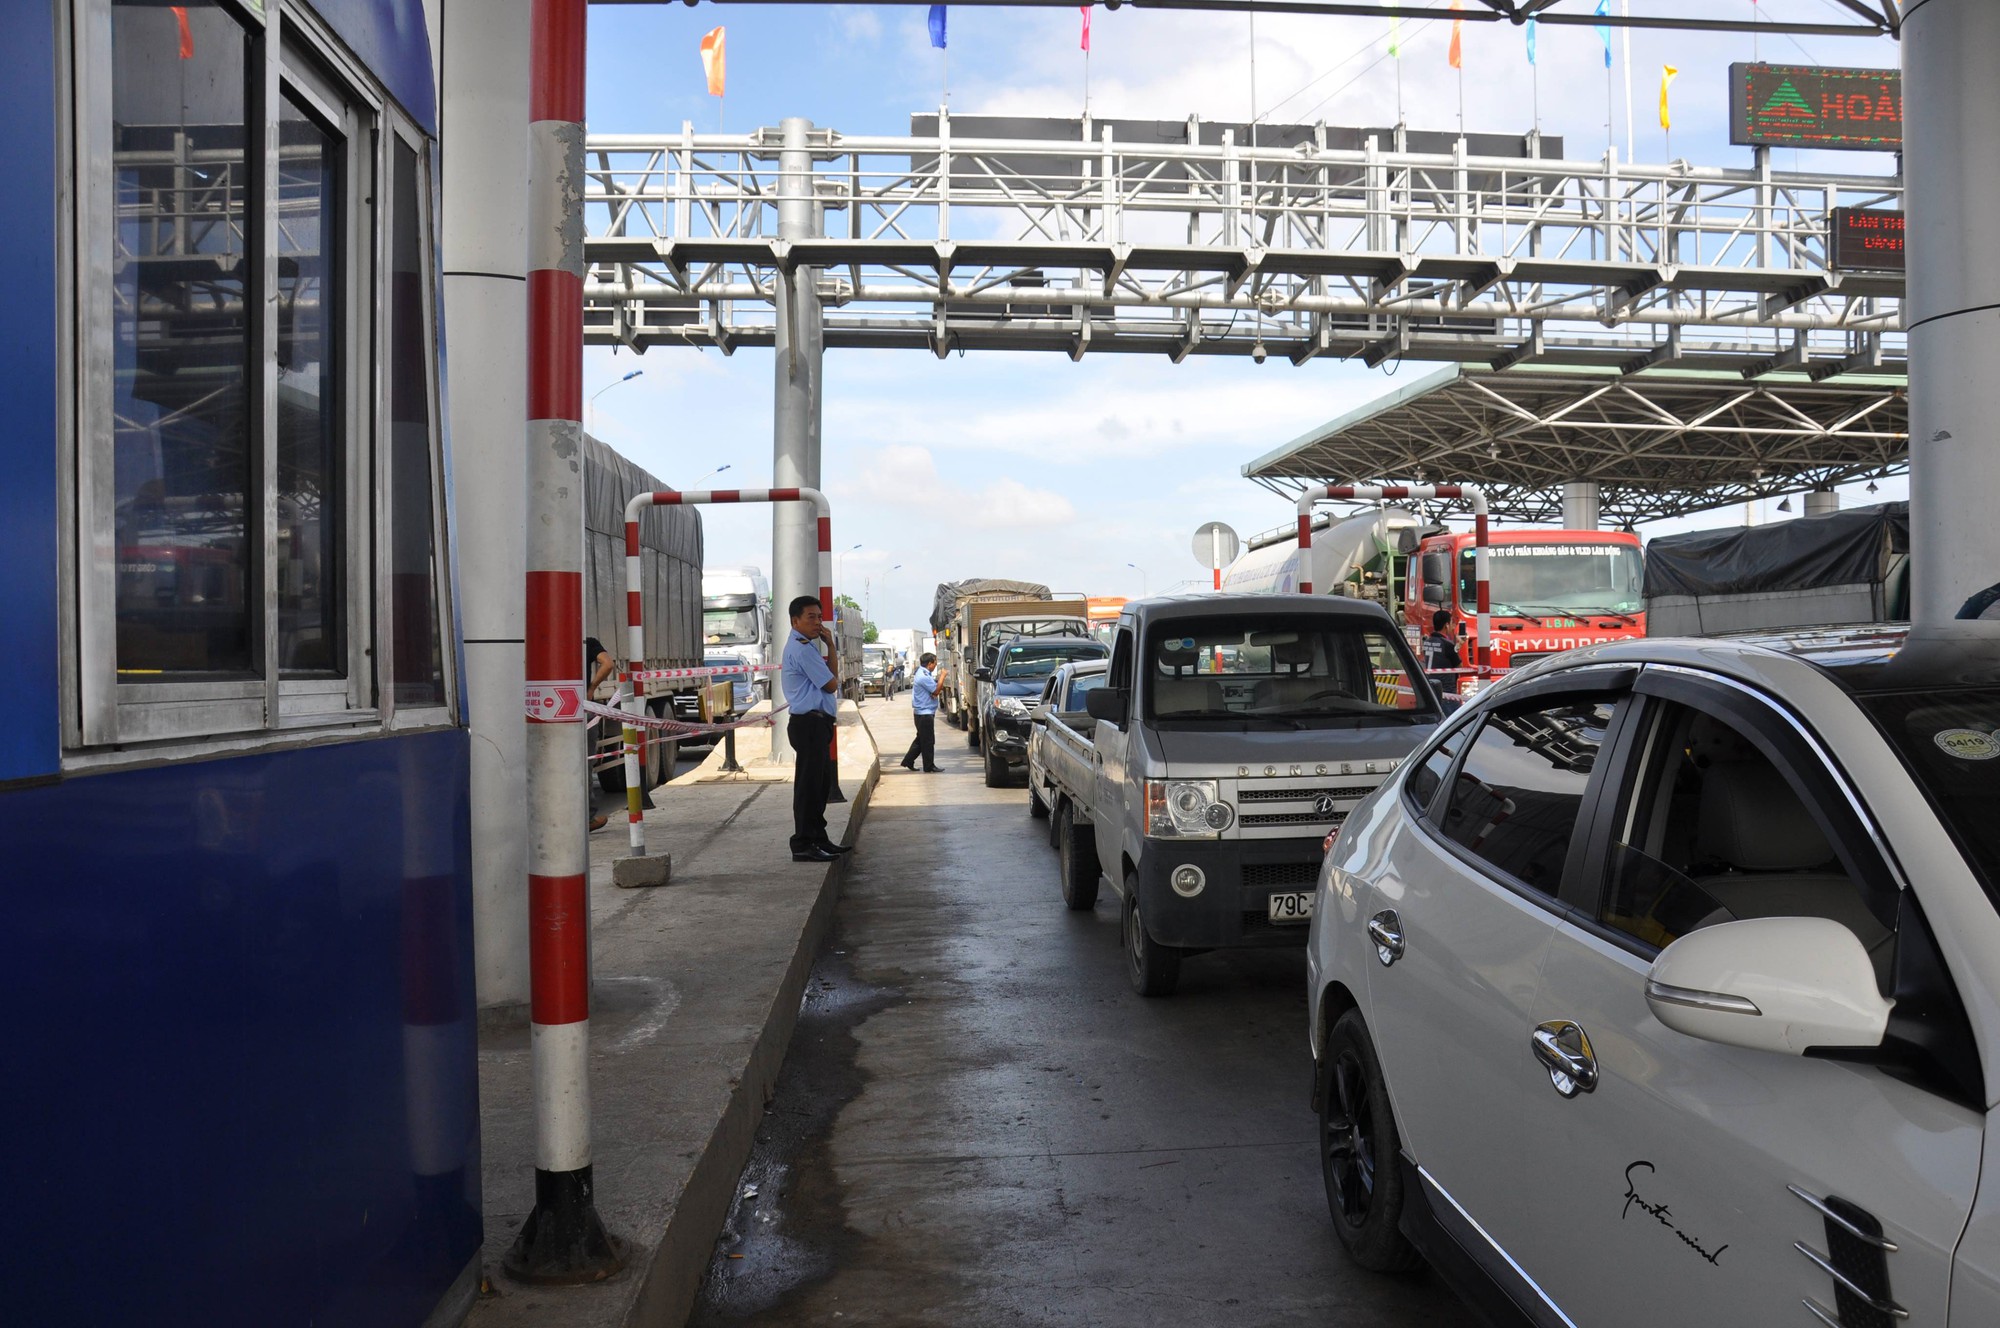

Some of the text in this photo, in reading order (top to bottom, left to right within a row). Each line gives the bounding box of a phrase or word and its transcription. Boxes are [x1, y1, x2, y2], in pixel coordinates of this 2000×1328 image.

[1821, 84, 1903, 121] HOÀ
[1882, 217, 1906, 230] TH
[1546, 619, 1576, 628] LBM
[1514, 636, 1614, 650] HYUND
[1946, 737, 1985, 748] 04/19
